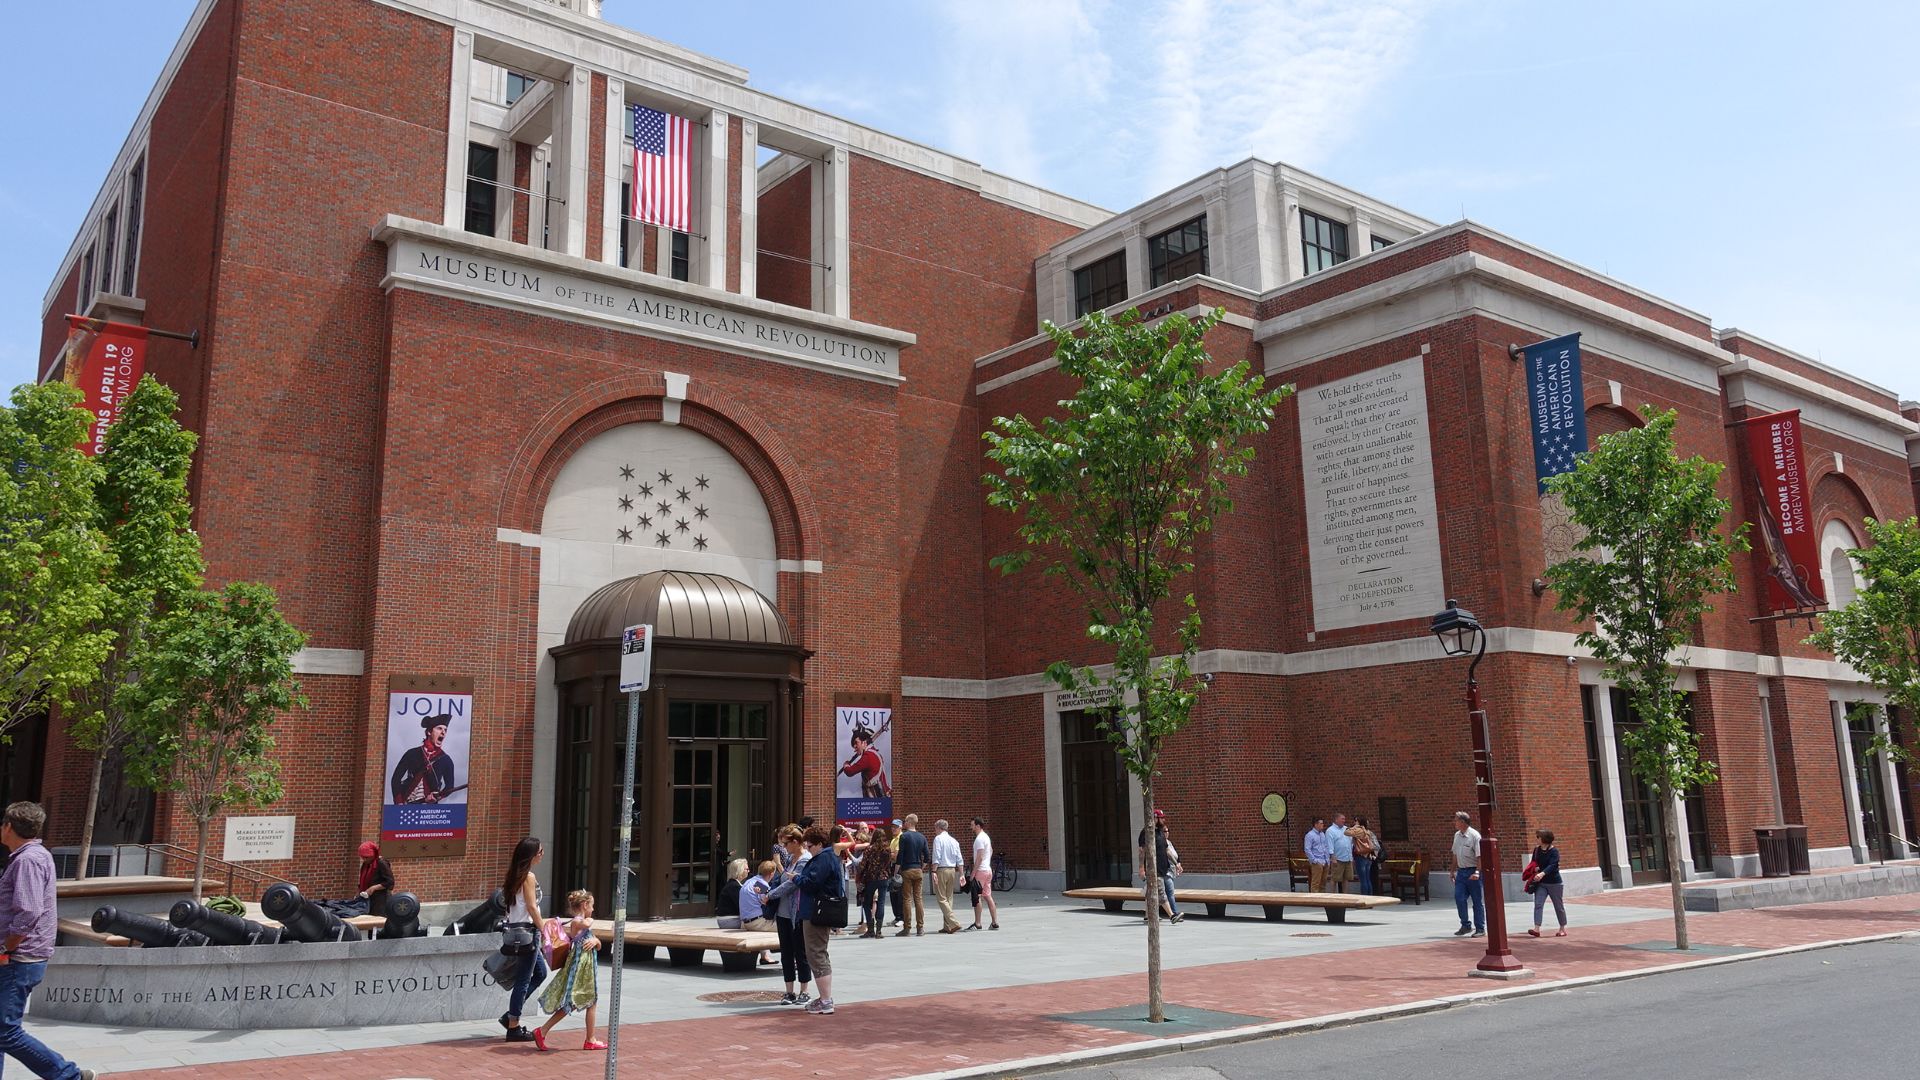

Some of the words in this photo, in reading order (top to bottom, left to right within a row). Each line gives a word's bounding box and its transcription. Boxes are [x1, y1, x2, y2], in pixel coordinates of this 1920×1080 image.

[419, 252, 542, 292] MUSEUM
[555, 285, 576, 300] OF
[582, 290, 615, 308] THE
[627, 297, 746, 335] AMERICAN
[755, 324, 887, 366] REVOLUTION
[105, 344, 118, 358] 19
[100, 365, 116, 404] APRIL
[1318, 388, 1332, 400] We
[1334, 385, 1350, 398] hold
[1353, 382, 1374, 392] these
[1376, 372, 1402, 385] truths
[1537, 372, 1544, 382] OF
[1548, 364, 1561, 430] AMERICAN
[1560, 350, 1574, 428] REVOLUTION
[1313, 415, 1332, 426] That
[1334, 410, 1342, 420] all
[1346, 406, 1362, 416] men
[1366, 404, 1377, 412] are
[1379, 392, 1408, 408] created
[1328, 403, 1336, 411] to
[1338, 398, 1347, 408] be
[1536, 382, 1549, 434] MUSEUM
[1351, 417, 1367, 427] that
[1370, 412, 1385, 422] they
[1388, 408, 1400, 417] are
[94, 409, 111, 454] OPENS
[1352, 432, 1361, 442] by
[1363, 427, 1382, 438] their
[1316, 451, 1334, 461] with
[1336, 444, 1364, 456] certain
[1366, 430, 1412, 448] unalienable
[1344, 456, 1360, 467] that
[1362, 450, 1390, 462] among
[1393, 444, 1415, 455] these
[1771, 423, 1784, 469] MEMBER
[1321, 476, 1333, 484] are
[1382, 460, 1398, 470] and
[1400, 456, 1414, 466] the
[1783, 420, 1806, 532] AMREVMUSEUM.ORG
[1326, 484, 1354, 498] pursuit
[1356, 479, 1366, 490] of
[1326, 499, 1346, 508] That
[1348, 495, 1358, 503] to
[1360, 490, 1386, 500] secure
[1388, 484, 1410, 494] these
[1351, 498, 1402, 516] governments
[1404, 494, 1418, 503] are
[1778, 486, 1793, 534] BECOME
[1326, 516, 1364, 531] instituted
[1366, 510, 1394, 522] among
[1396, 507, 1416, 516] men,
[1323, 533, 1354, 545] deriving
[1356, 529, 1374, 539] their
[1376, 525, 1392, 536] just
[1395, 520, 1424, 534] powers
[1336, 545, 1357, 554] from
[1359, 540, 1372, 550] the
[1374, 534, 1409, 548] consent
[1340, 555, 1350, 566] of
[1352, 554, 1364, 564] the
[1348, 576, 1403, 592] DECLARATION
[1352, 584, 1414, 600] INDEPENDENCE
[1360, 604, 1372, 612] July
[624, 642, 631, 654] 57
[397, 697, 464, 716] JOIN
[1057, 693, 1071, 702] JOHN
[1062, 698, 1094, 707] EDUCATION
[842, 710, 886, 726] VISIT
[45, 987, 125, 1004] MUSEUM
[133, 992, 152, 1004] OF
[161, 990, 192, 1003] THE
[204, 982, 336, 1002] AMERICAN
[354, 972, 498, 996] REVOLUTIO
